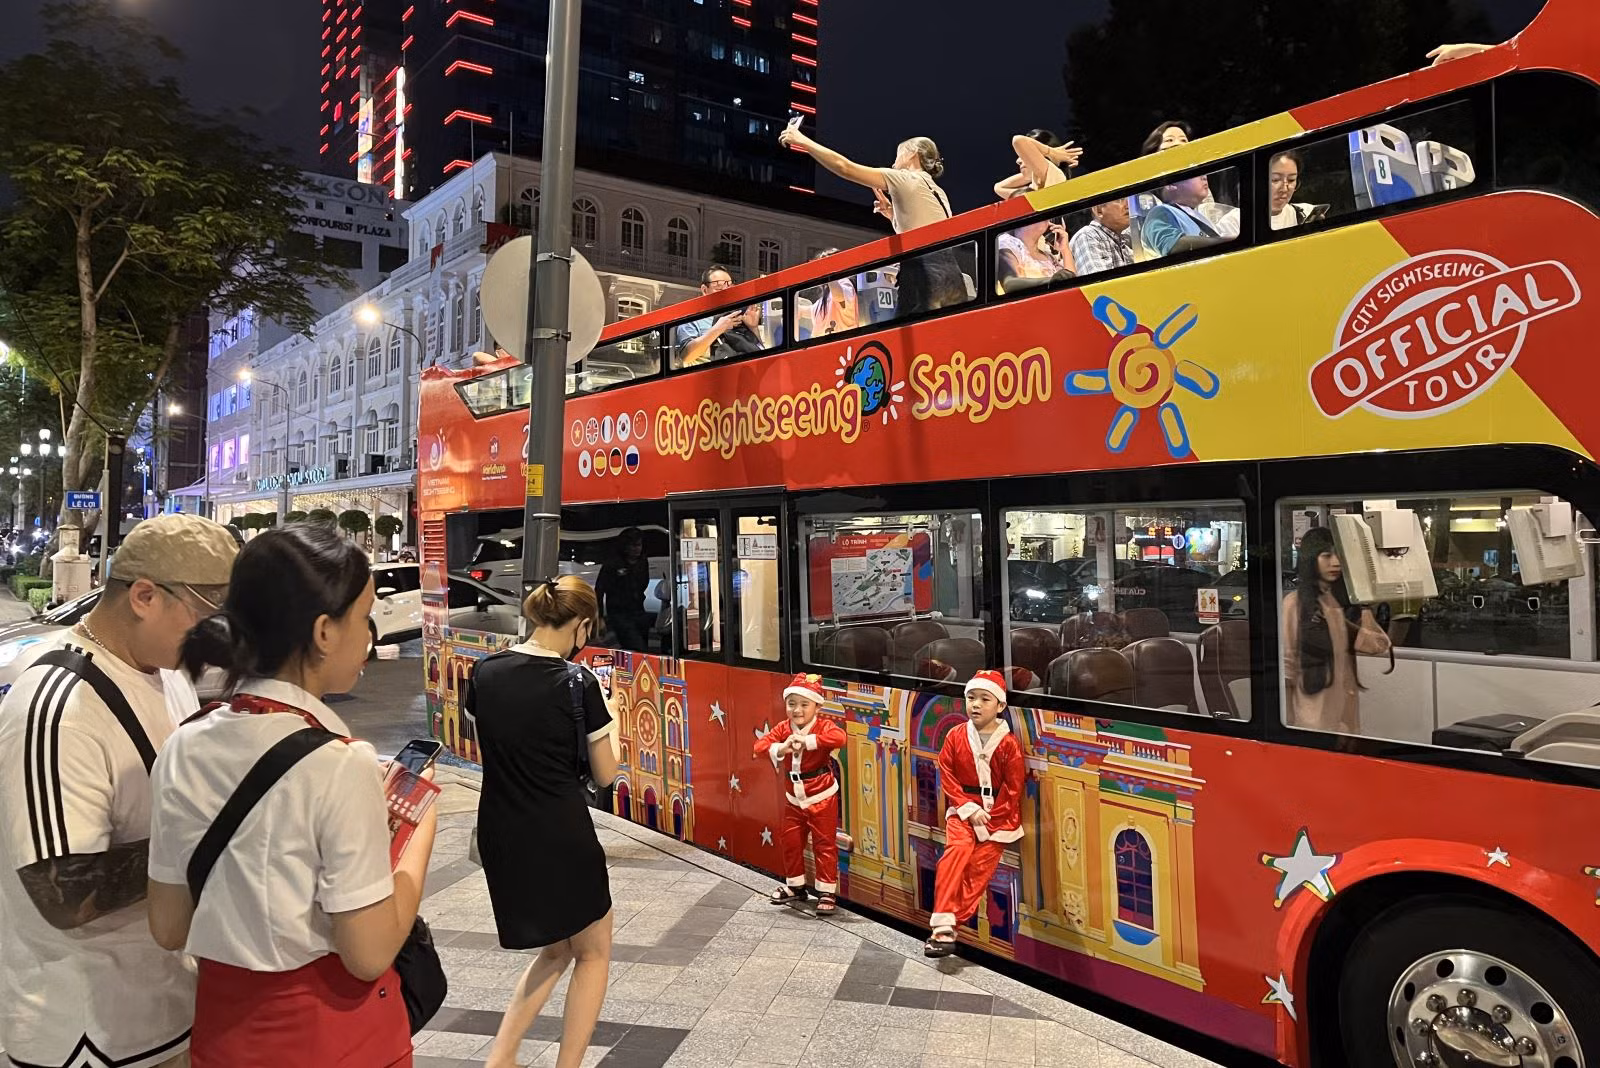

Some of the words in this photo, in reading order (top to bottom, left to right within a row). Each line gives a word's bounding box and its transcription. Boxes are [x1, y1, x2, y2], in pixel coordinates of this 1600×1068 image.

[1378, 159, 1387, 180] 8
[356, 224, 392, 237] PLAZA
[879, 291, 892, 306] 20
[1351, 297, 1379, 334] CITY
[1376, 261, 1486, 305] SIGHTSEEING
[1332, 272, 1560, 398] OFFICIAL
[909, 346, 1053, 424] Saigon
[1403, 343, 1507, 405] TOUR
